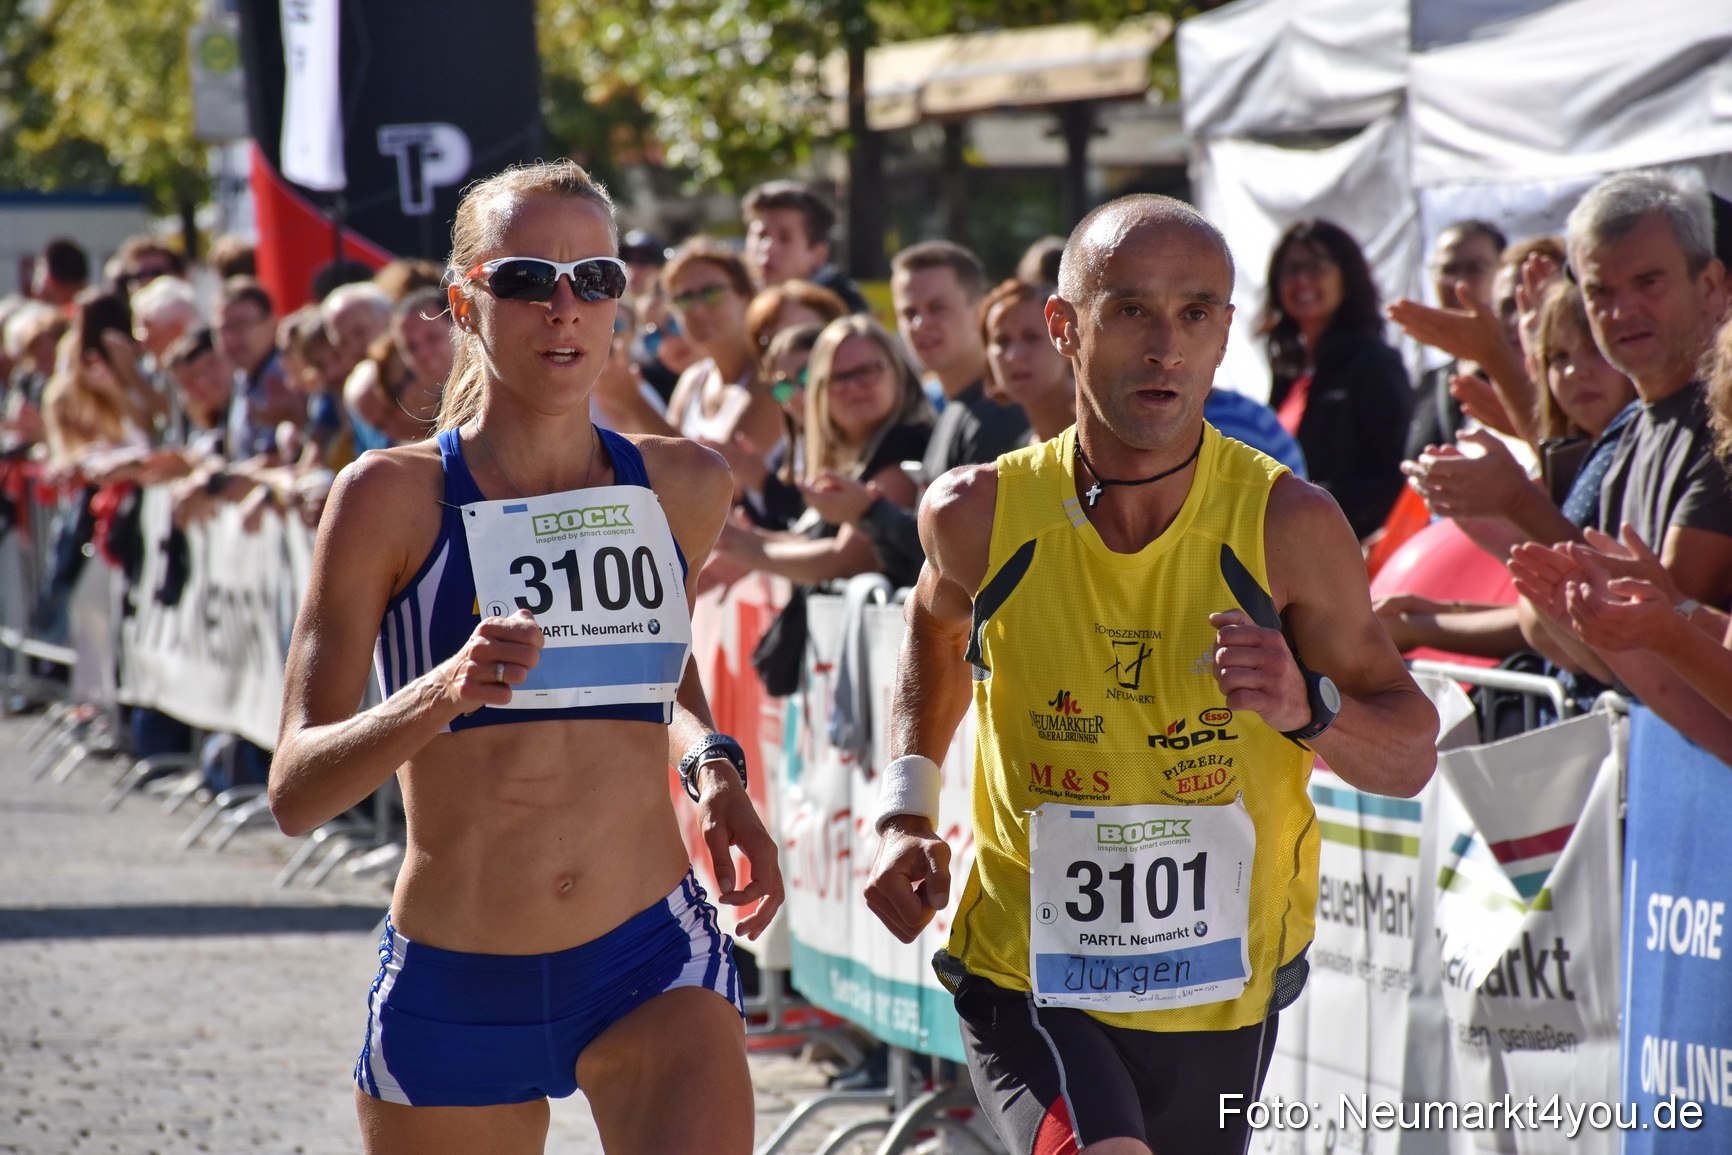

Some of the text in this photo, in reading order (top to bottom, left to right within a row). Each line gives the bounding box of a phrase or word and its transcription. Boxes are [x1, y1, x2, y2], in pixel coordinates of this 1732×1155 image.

[532, 505, 633, 536] BOCK
[536, 527, 636, 544] inspired by smart concepts
[509, 545, 664, 616] 3100
[539, 621, 644, 637] ARTL Neumarkt
[1028, 709, 1105, 733] NEUMARKTER
[1030, 763, 1110, 793] M & S
[1162, 754, 1233, 780] PIZZERIA
[1176, 768, 1227, 795] ELIO
[1097, 819, 1192, 844] BOCK
[1097, 837, 1191, 853] inspired by smart concepts
[1065, 852, 1207, 923] 3101
[1079, 927, 1189, 946] PARTL Neumarkt
[1647, 892, 1725, 960] STORE
[1065, 956, 1190, 995] Jürgen
[1640, 1034, 1732, 1109] ONLINE
